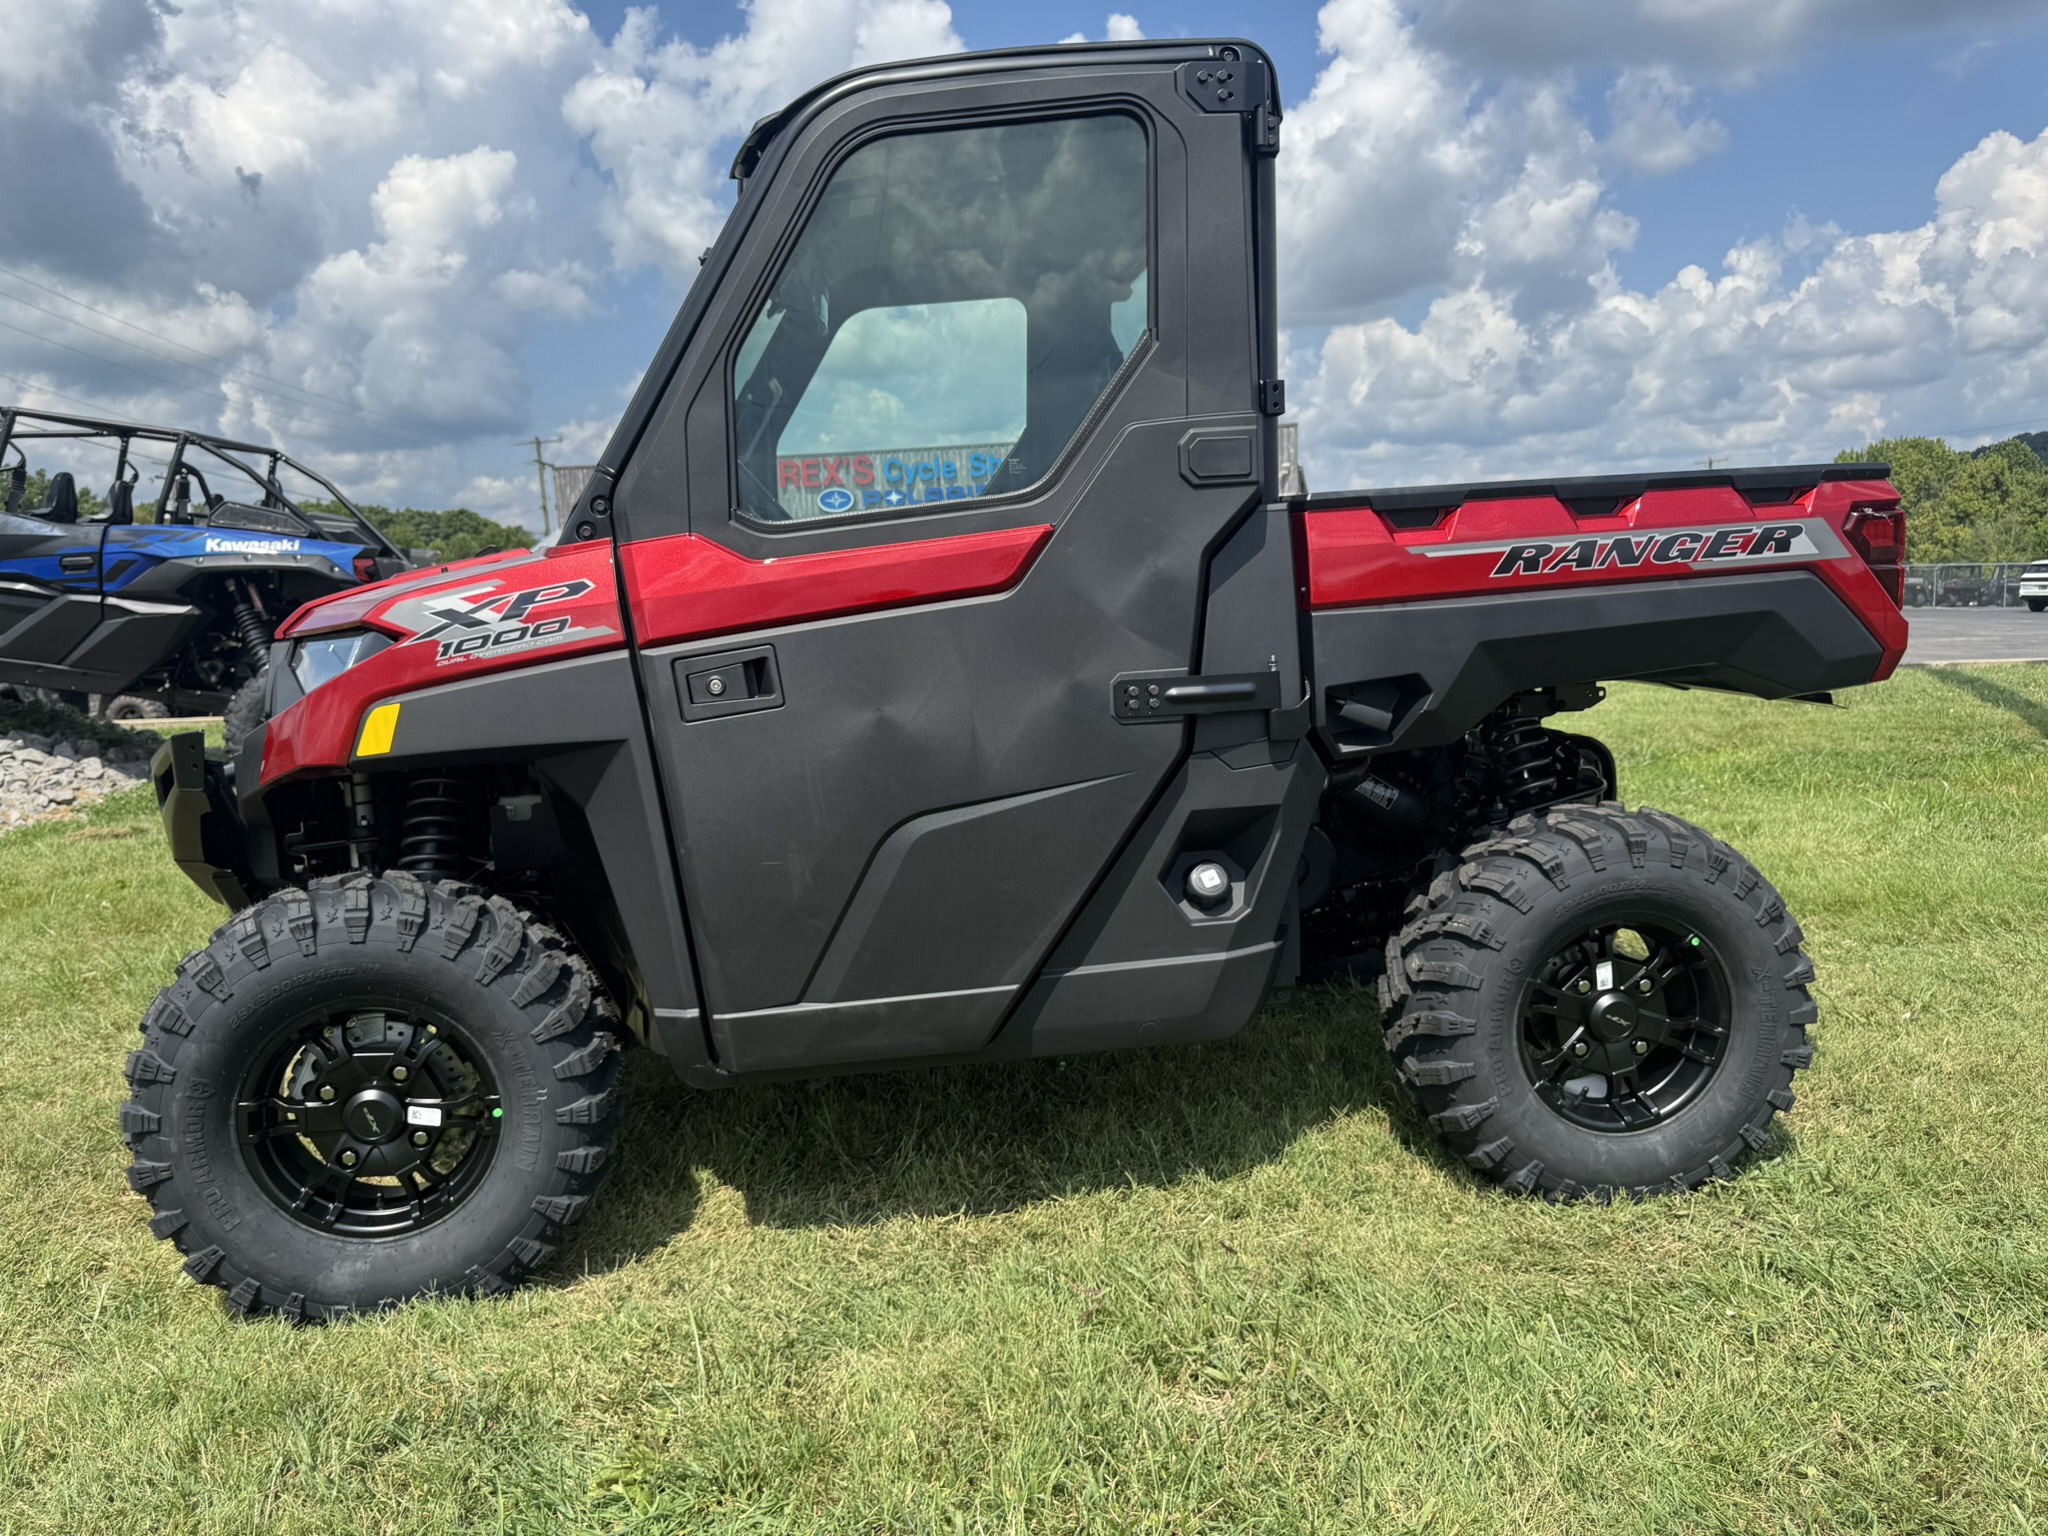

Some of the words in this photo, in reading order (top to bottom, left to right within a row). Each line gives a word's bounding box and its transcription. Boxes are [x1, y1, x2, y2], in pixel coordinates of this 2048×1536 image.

[778, 456, 875, 488] REX'S
[884, 455, 957, 485] Cycle
[205, 538, 300, 553] Kawasaki
[1489, 524, 1806, 577] RANGER
[397, 578, 596, 648] XP
[435, 616, 571, 660] 1000
[436, 654, 468, 667] DUAL
[470, 641, 536, 660] OVERHEAD
[536, 635, 564, 647] CAM
[185, 1100, 215, 1184] ARMOR
[203, 1184, 242, 1232] PRO
